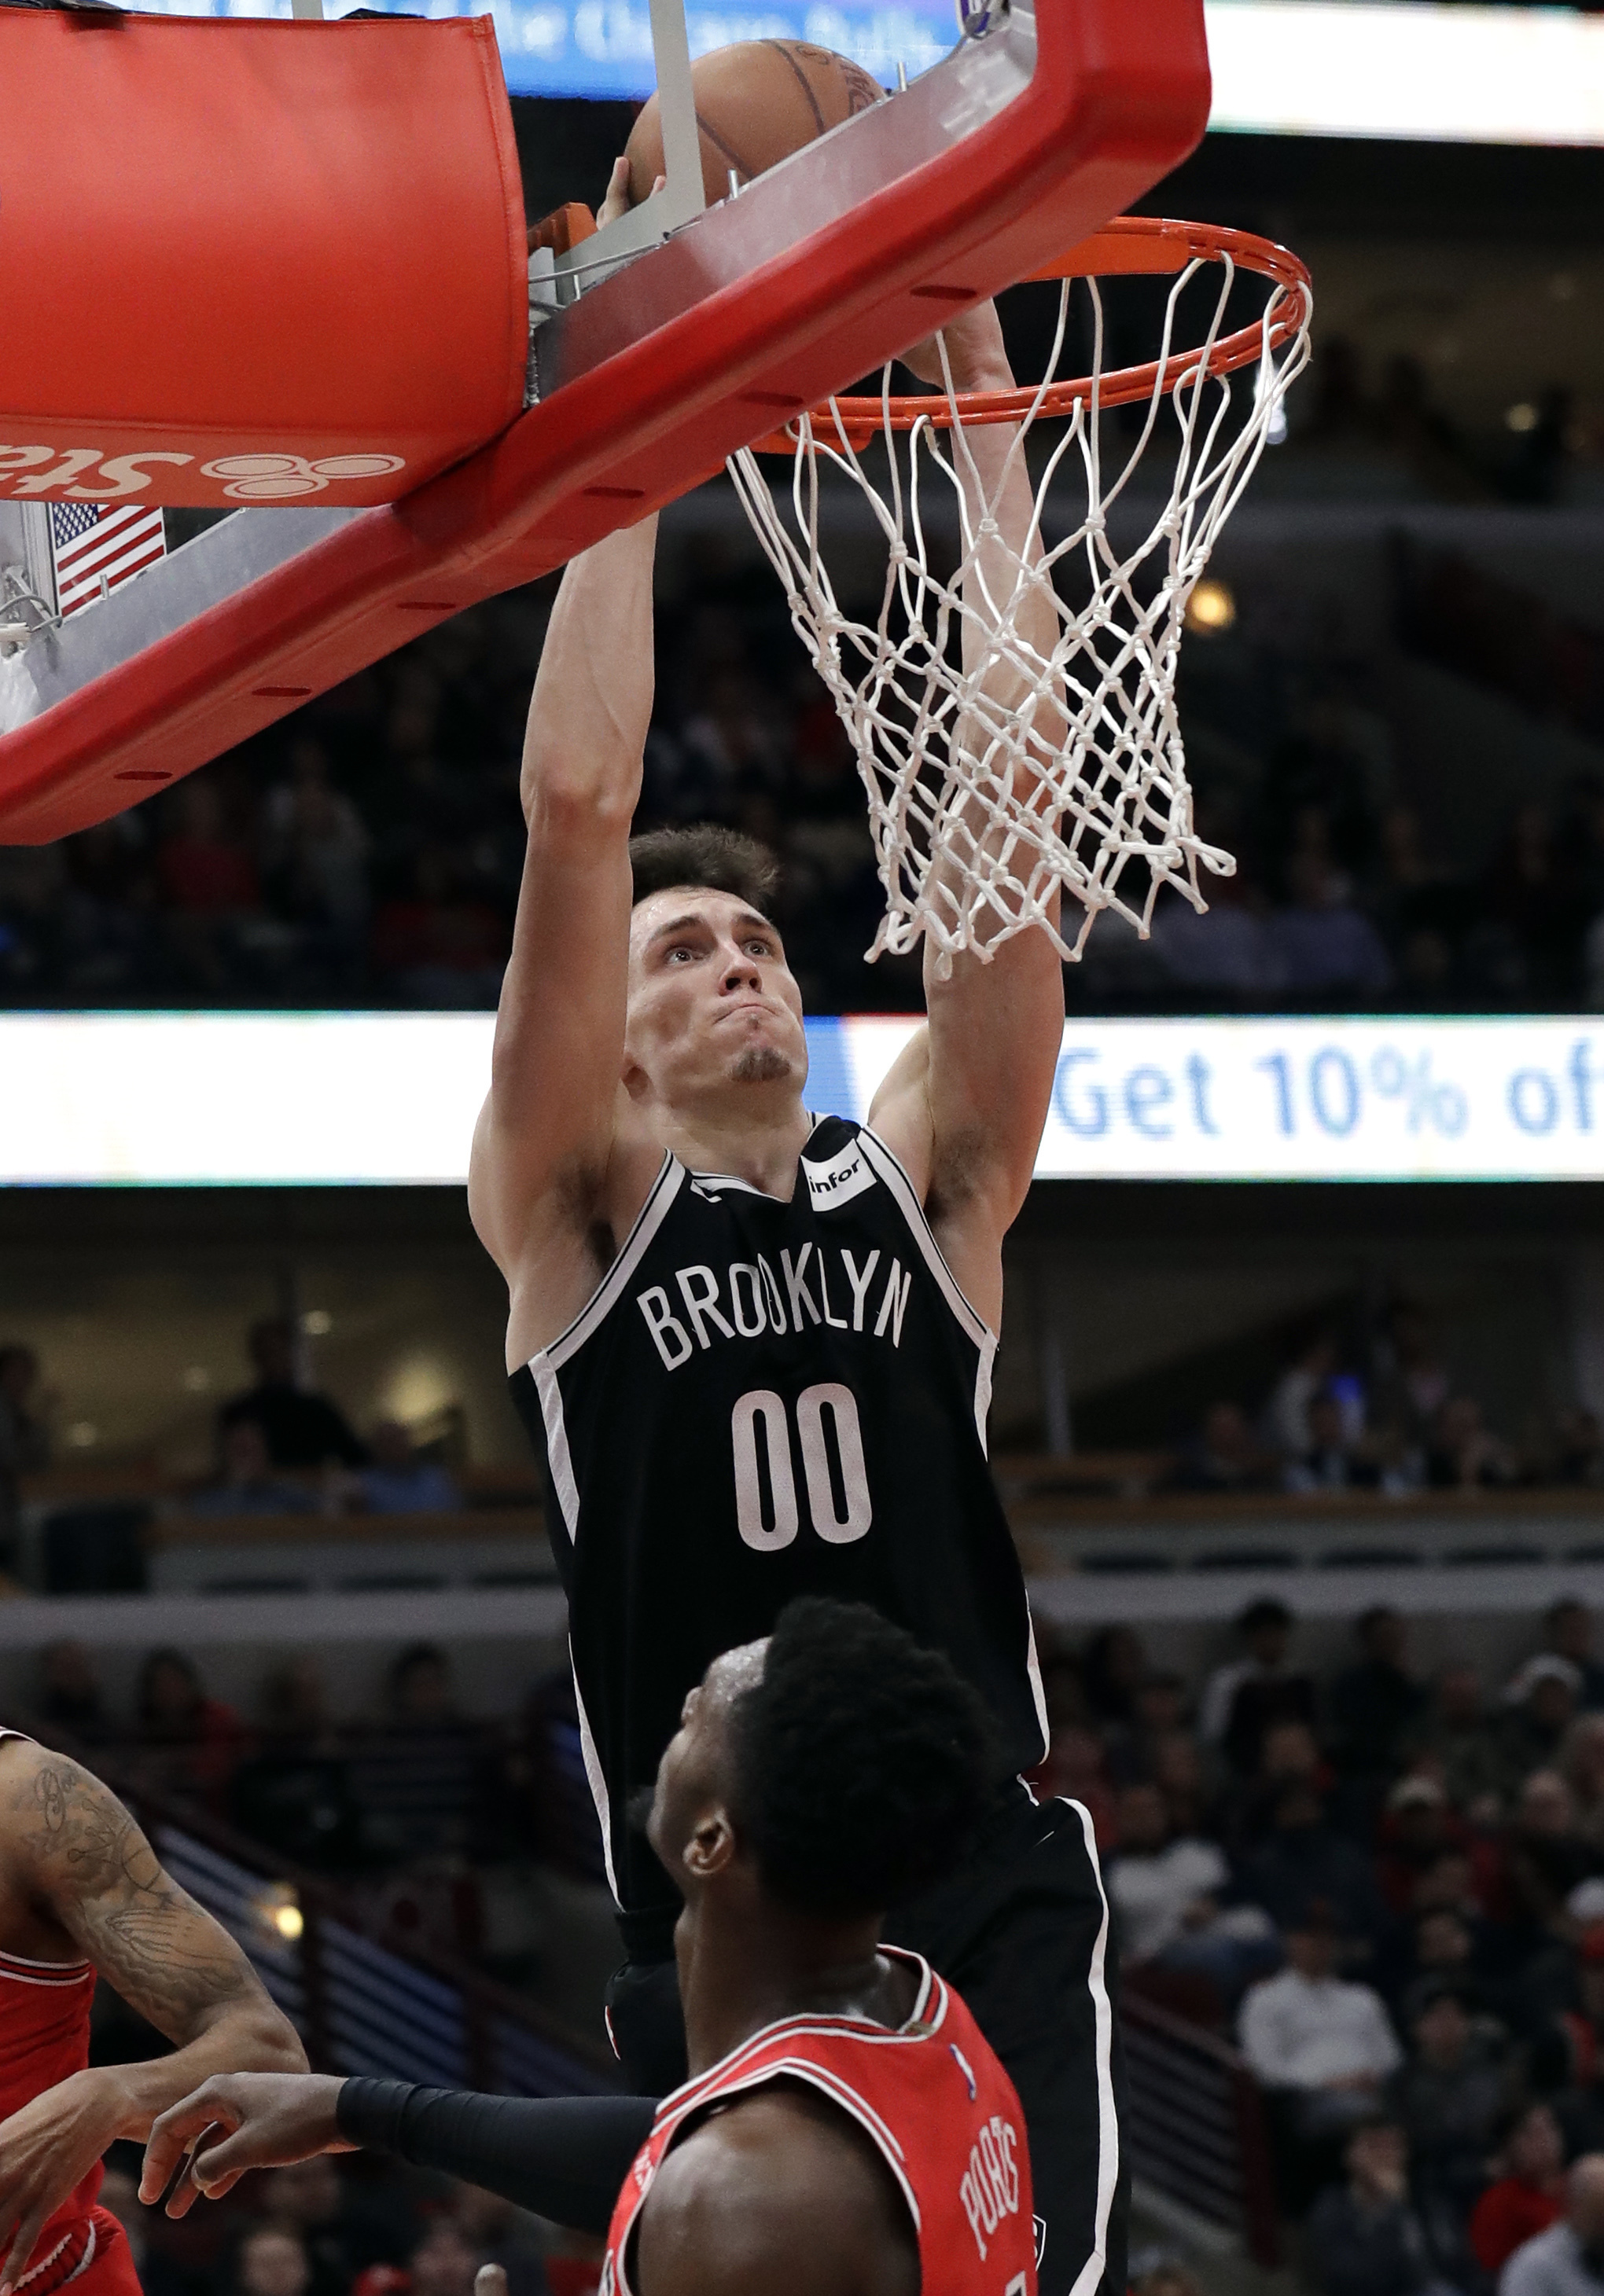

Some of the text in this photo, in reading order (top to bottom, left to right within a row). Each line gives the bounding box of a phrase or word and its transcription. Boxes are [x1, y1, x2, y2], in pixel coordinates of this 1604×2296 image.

[1052, 1047, 1220, 1139] Get
[1253, 1043, 1470, 1140] 10%
[808, 1158, 859, 1193] infor
[636, 1241, 912, 1372] BROOKLYN
[731, 1383, 873, 1552] 00
